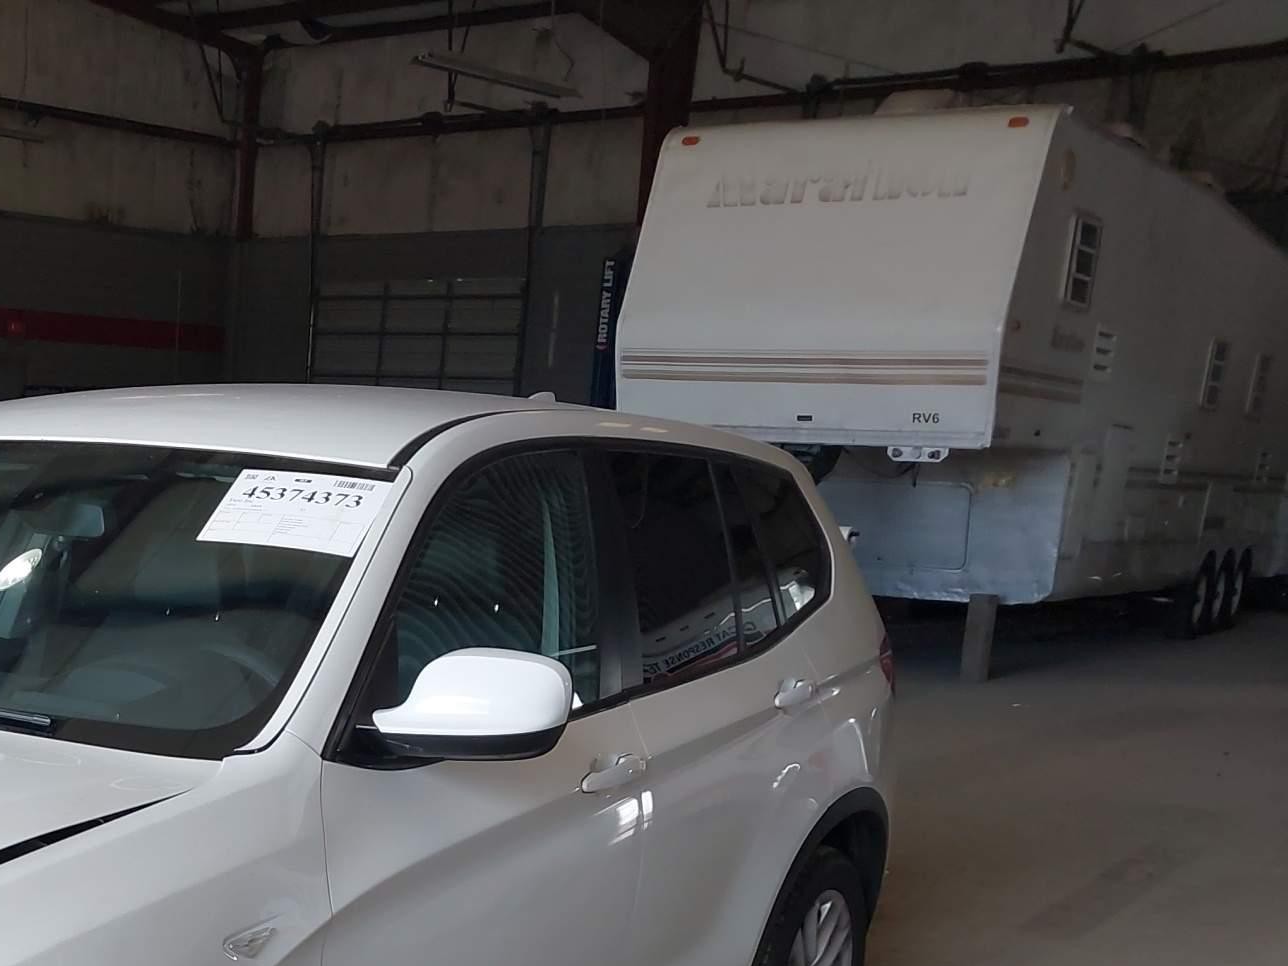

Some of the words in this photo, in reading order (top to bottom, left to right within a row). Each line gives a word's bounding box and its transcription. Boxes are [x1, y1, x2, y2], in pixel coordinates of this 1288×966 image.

[603, 260, 615, 287] LIFT
[598, 291, 611, 343] ROTARY
[912, 412, 940, 424] RV6
[242, 486, 364, 508] 45374373
